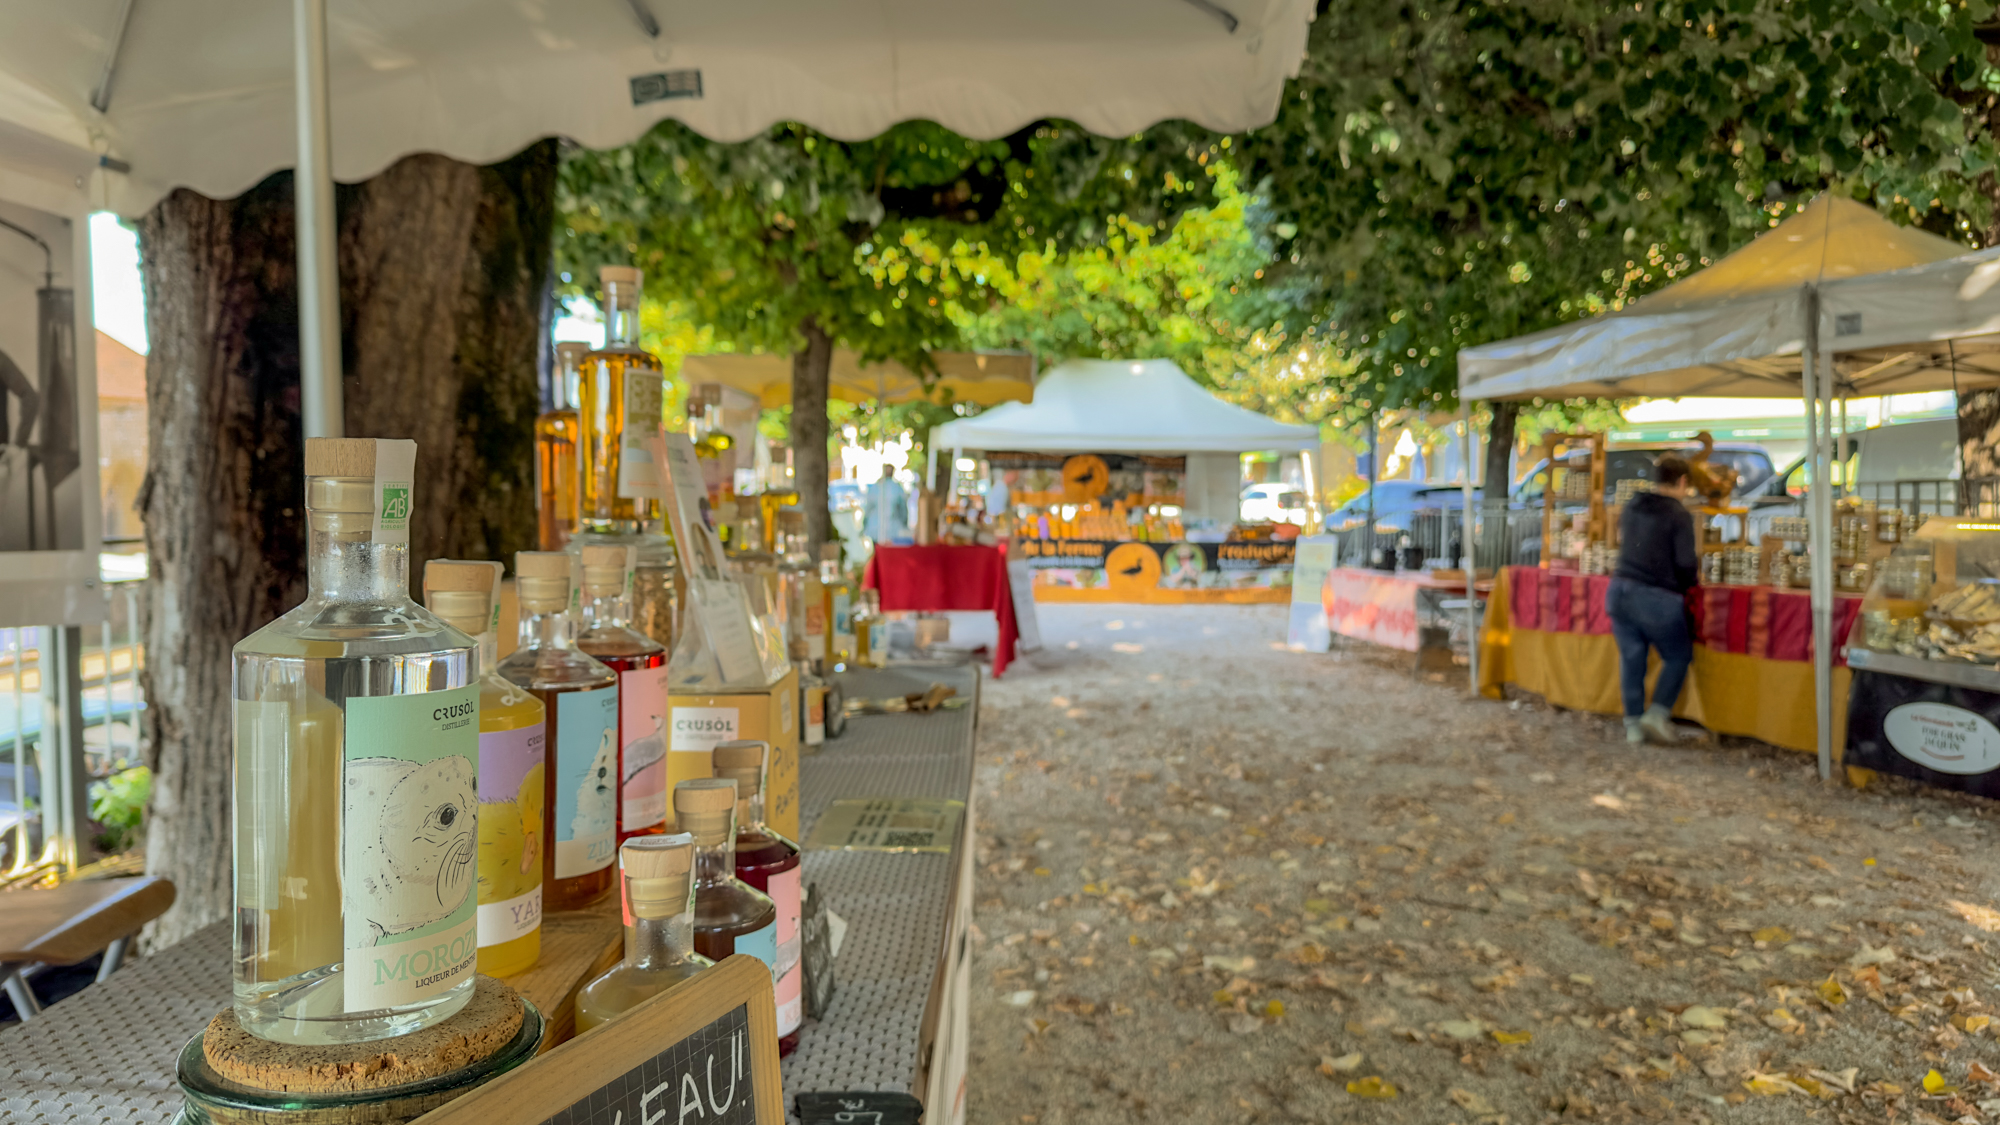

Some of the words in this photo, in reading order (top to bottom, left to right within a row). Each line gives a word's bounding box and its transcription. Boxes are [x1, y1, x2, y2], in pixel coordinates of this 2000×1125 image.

[384, 497, 406, 518] AB
[433, 698, 475, 721] CRUSÒL
[676, 716, 734, 732] CRUSÒL
[415, 969, 450, 988] LIQUEUR
[450, 965, 460, 976] DE
